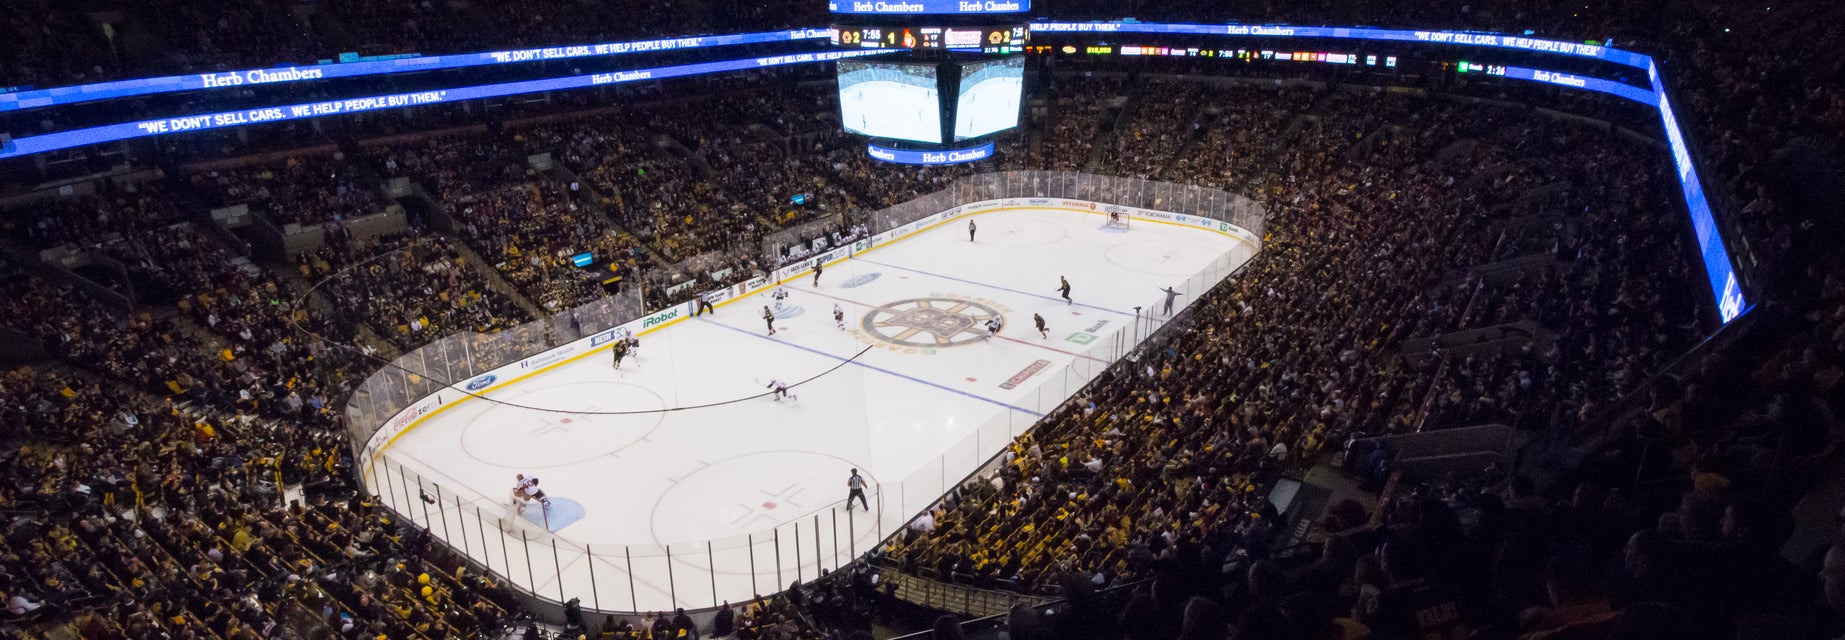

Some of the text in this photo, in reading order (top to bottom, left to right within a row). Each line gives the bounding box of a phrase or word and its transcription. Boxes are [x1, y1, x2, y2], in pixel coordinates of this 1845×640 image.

[854, 1, 924, 12] Herb Chambers
[959, 1, 982, 11] Herb
[1030, 23, 1049, 31] HELP
[1050, 23, 1077, 32] PEOPLE
[1078, 23, 1094, 32] BUY
[1228, 25, 1294, 36] Herb Chambers
[853, 31, 860, 43] 2
[888, 32, 895, 45] 1
[1003, 31, 1010, 43] 2
[1455, 34, 1473, 44] SELL
[1475, 35, 1498, 46] CARS.
[1503, 36, 1515, 47] WE
[1516, 37, 1532, 48] HELP
[1533, 39, 1559, 52] PEOPLE
[1560, 42, 1576, 53] BUY
[543, 47, 565, 59] SELL
[567, 45, 591, 57] CARS.
[596, 43, 608, 55] WE
[610, 42, 630, 54] HELP
[631, 40, 660, 53] PEOPLE
[662, 39, 676, 51] BUY
[201, 66, 323, 88] Herb Chambers
[592, 70, 650, 85] Herb Chambers
[1533, 70, 1585, 87] Herb Chambers
[139, 90, 447, 134] “WE DON'T SELL CARS. WE HELP PEOPLE BUY THEM.”
[923, 149, 985, 163] Herb Chambers
[820, 247, 846, 263] UPERCUTS
[643, 308, 678, 328] iRobot
[471, 376, 495, 390] Ford
